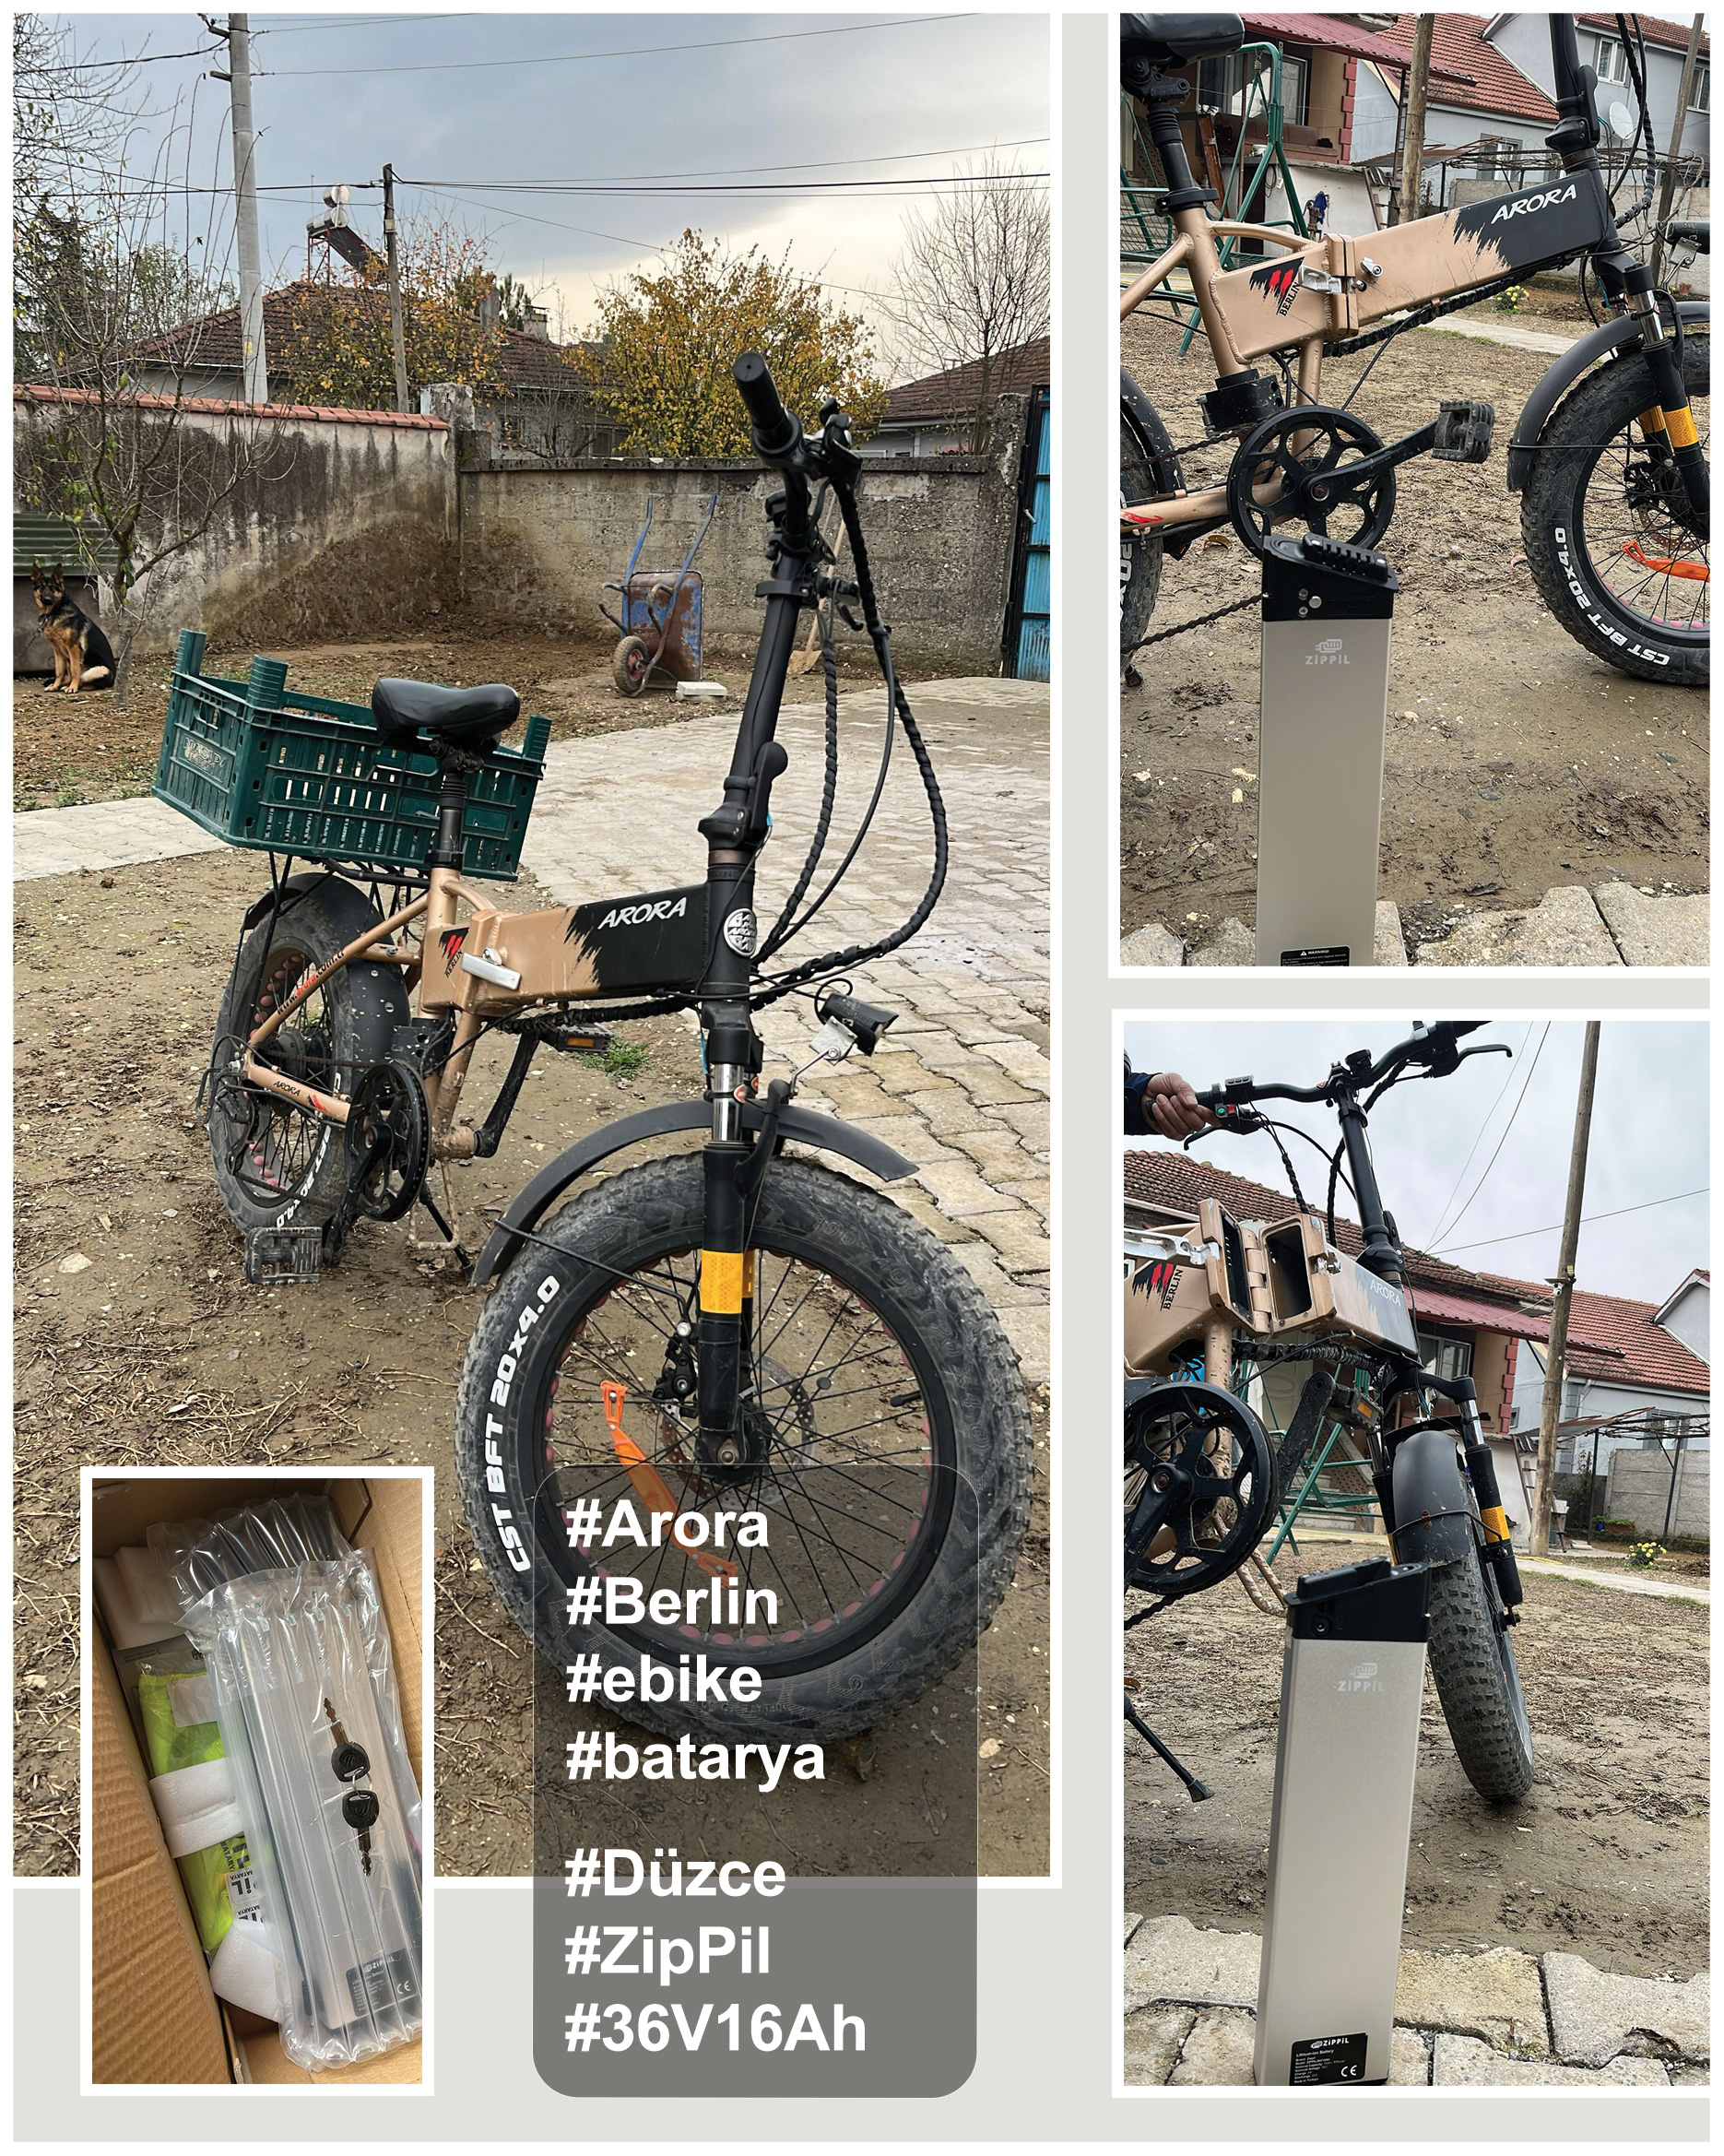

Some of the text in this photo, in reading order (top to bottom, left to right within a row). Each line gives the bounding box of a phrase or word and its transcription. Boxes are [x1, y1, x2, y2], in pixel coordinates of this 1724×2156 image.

[1491, 184, 1577, 225] ARORA
[1279, 281, 1300, 316] BERLIN
[1588, 613, 1628, 646] BFT
[1627, 644, 1671, 666] CST
[598, 896, 687, 930] ARORA
[273, 1081, 301, 1096] ARORA
[1163, 1269, 1185, 1310] BERLIN
[1369, 1278, 1401, 1307] ARORA
[485, 1412, 506, 1493] BFT
[490, 1502, 531, 1572] CST
